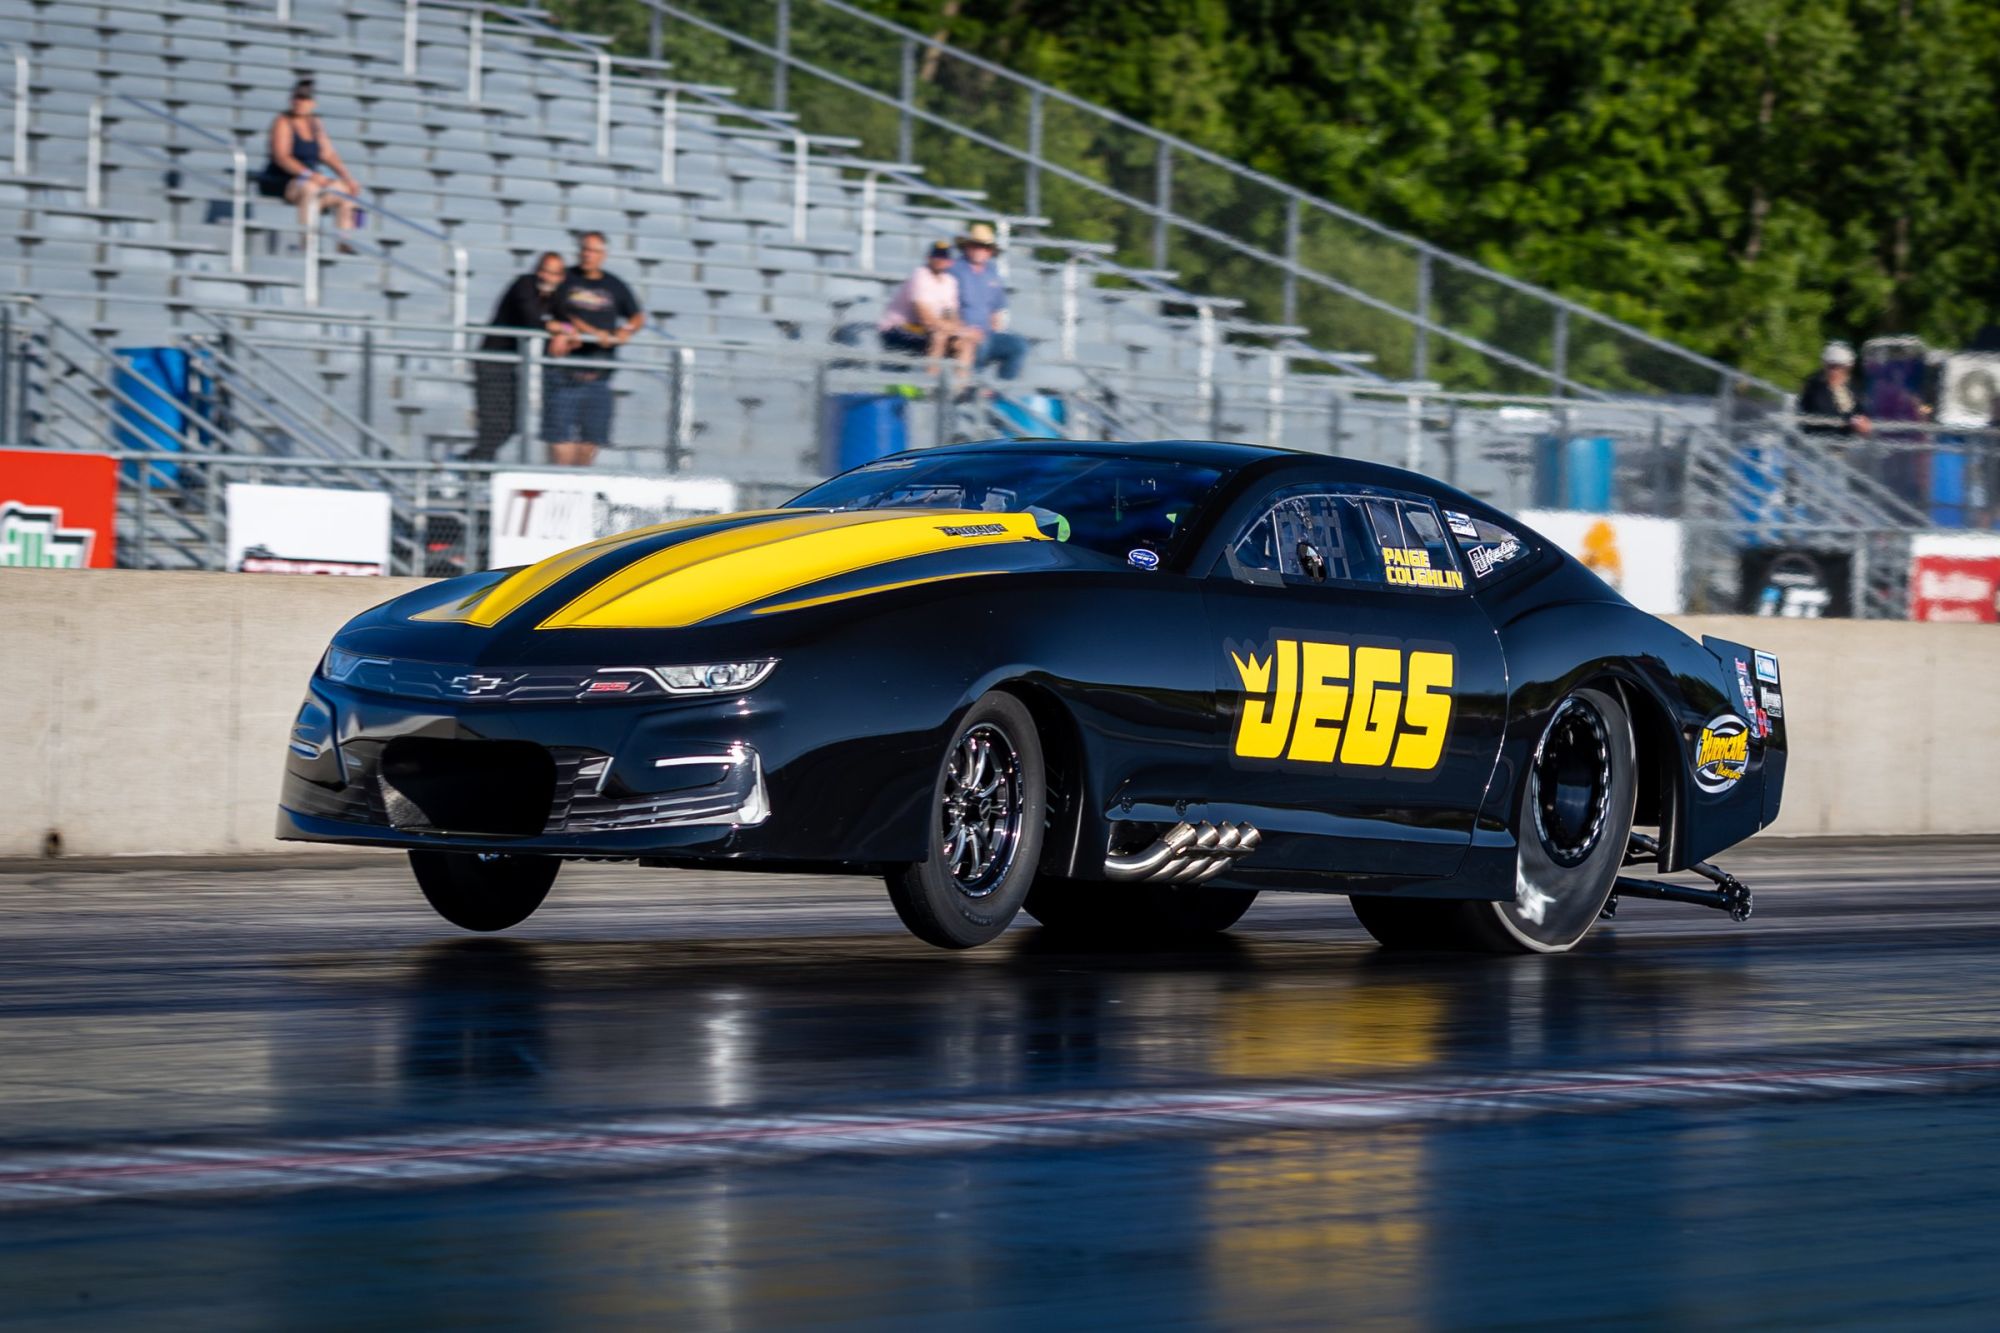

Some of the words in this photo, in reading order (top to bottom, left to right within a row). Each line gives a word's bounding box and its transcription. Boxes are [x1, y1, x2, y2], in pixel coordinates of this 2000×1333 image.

[1382, 547, 1430, 568] PAIGE
[1386, 566, 1464, 590] COUGHLIN
[1231, 639, 1453, 770] JEGS
